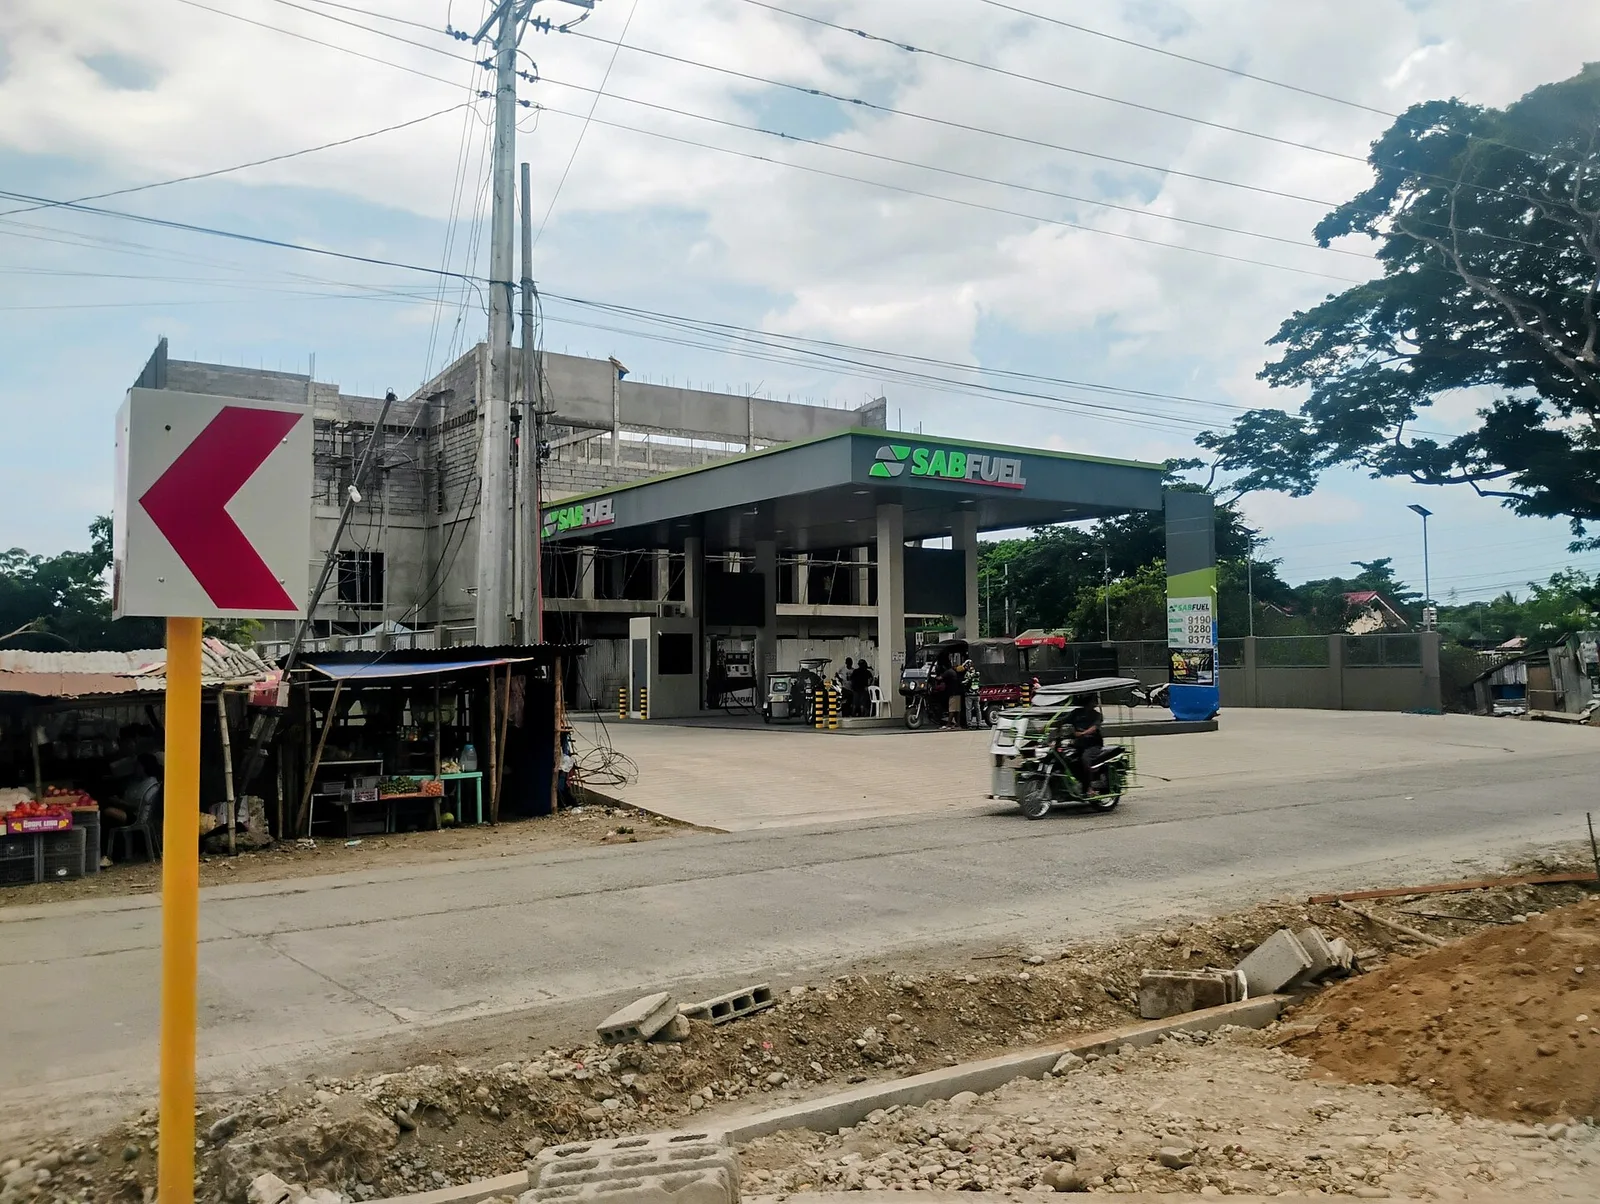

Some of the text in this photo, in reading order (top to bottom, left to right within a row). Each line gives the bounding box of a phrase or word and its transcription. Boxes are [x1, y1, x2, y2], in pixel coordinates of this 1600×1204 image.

[911, 447, 1027, 485] SABFUEL
[558, 498, 615, 531] SABFUEL
[1177, 603, 1210, 612] SABFUEL
[1188, 615, 1211, 624] 9190
[1188, 625, 1211, 634] 9280
[1188, 635, 1211, 644] 8375
